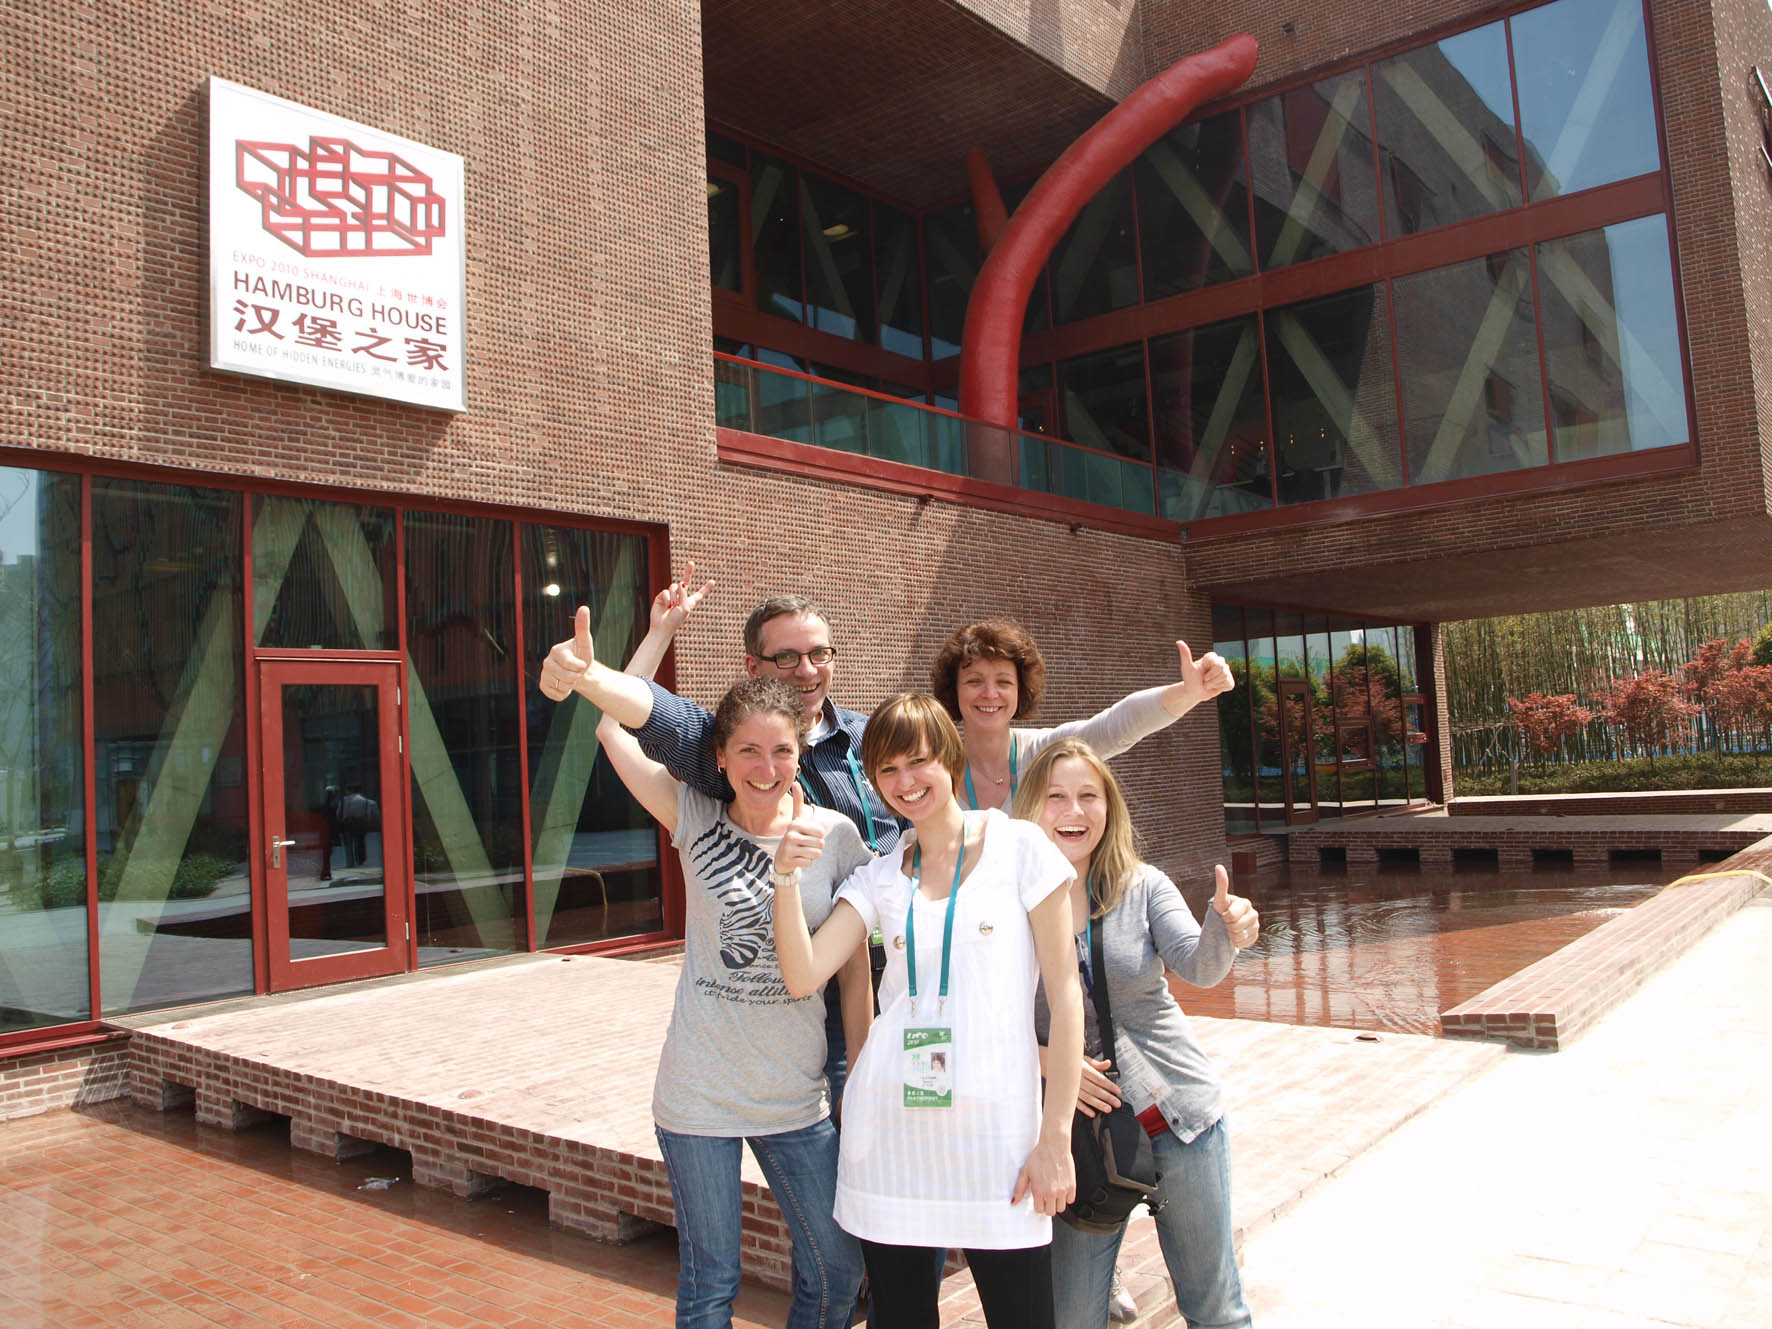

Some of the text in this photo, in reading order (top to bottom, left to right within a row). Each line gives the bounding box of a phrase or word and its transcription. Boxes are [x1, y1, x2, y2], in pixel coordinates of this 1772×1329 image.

[233, 250, 448, 309] EXPO 2010 SHANGHAI 上海世博会
[234, 270, 447, 335] HAMBURG HOUSE
[233, 299, 449, 371] 汉堡之家
[233, 339, 262, 355] HOME
[266, 345, 278, 357] OF
[282, 349, 318, 366] HIDDEN
[322, 355, 366, 374] ENERGIES
